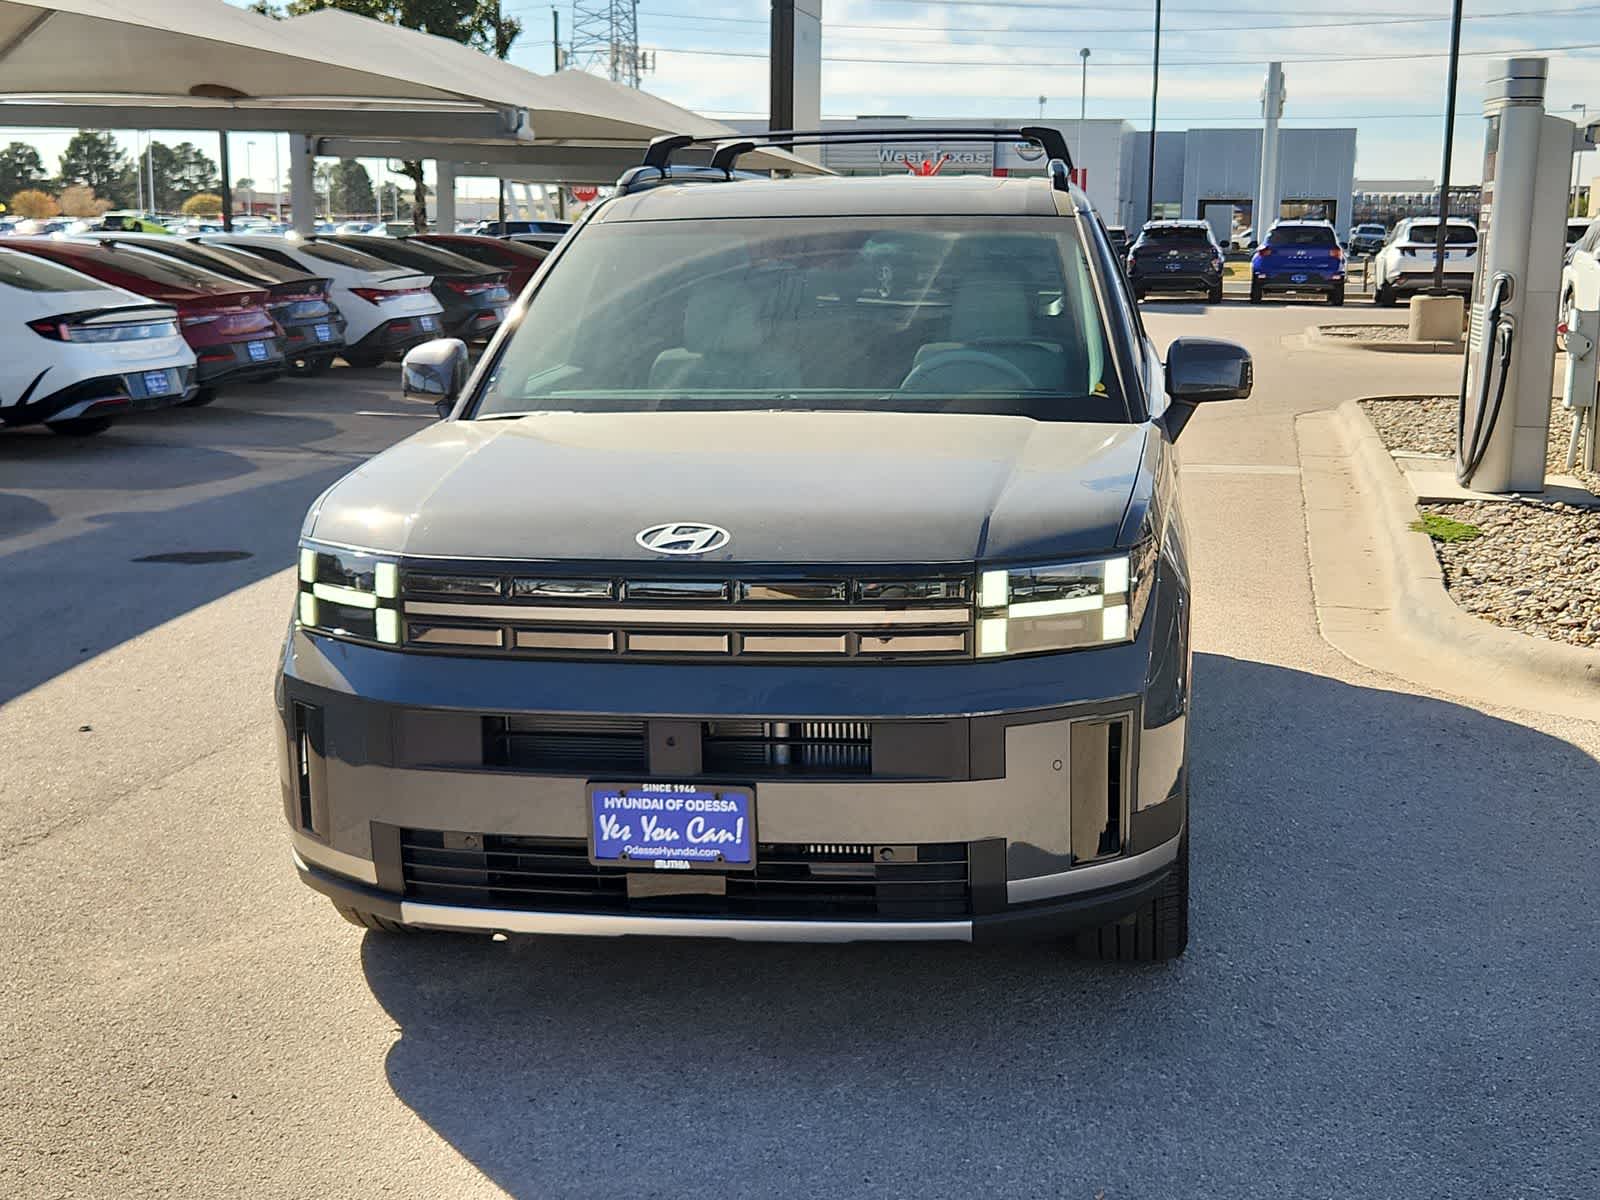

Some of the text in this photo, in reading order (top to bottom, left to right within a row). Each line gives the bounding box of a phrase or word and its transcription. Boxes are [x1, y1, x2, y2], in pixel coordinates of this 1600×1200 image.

[879, 150, 923, 163] West
[642, 783, 672, 792] SINCE
[604, 797, 738, 812] HYUNDAI OF ODESSA
[599, 814, 744, 844] Yes You Can!
[623, 845, 721, 857] OdessaHyundai.com
